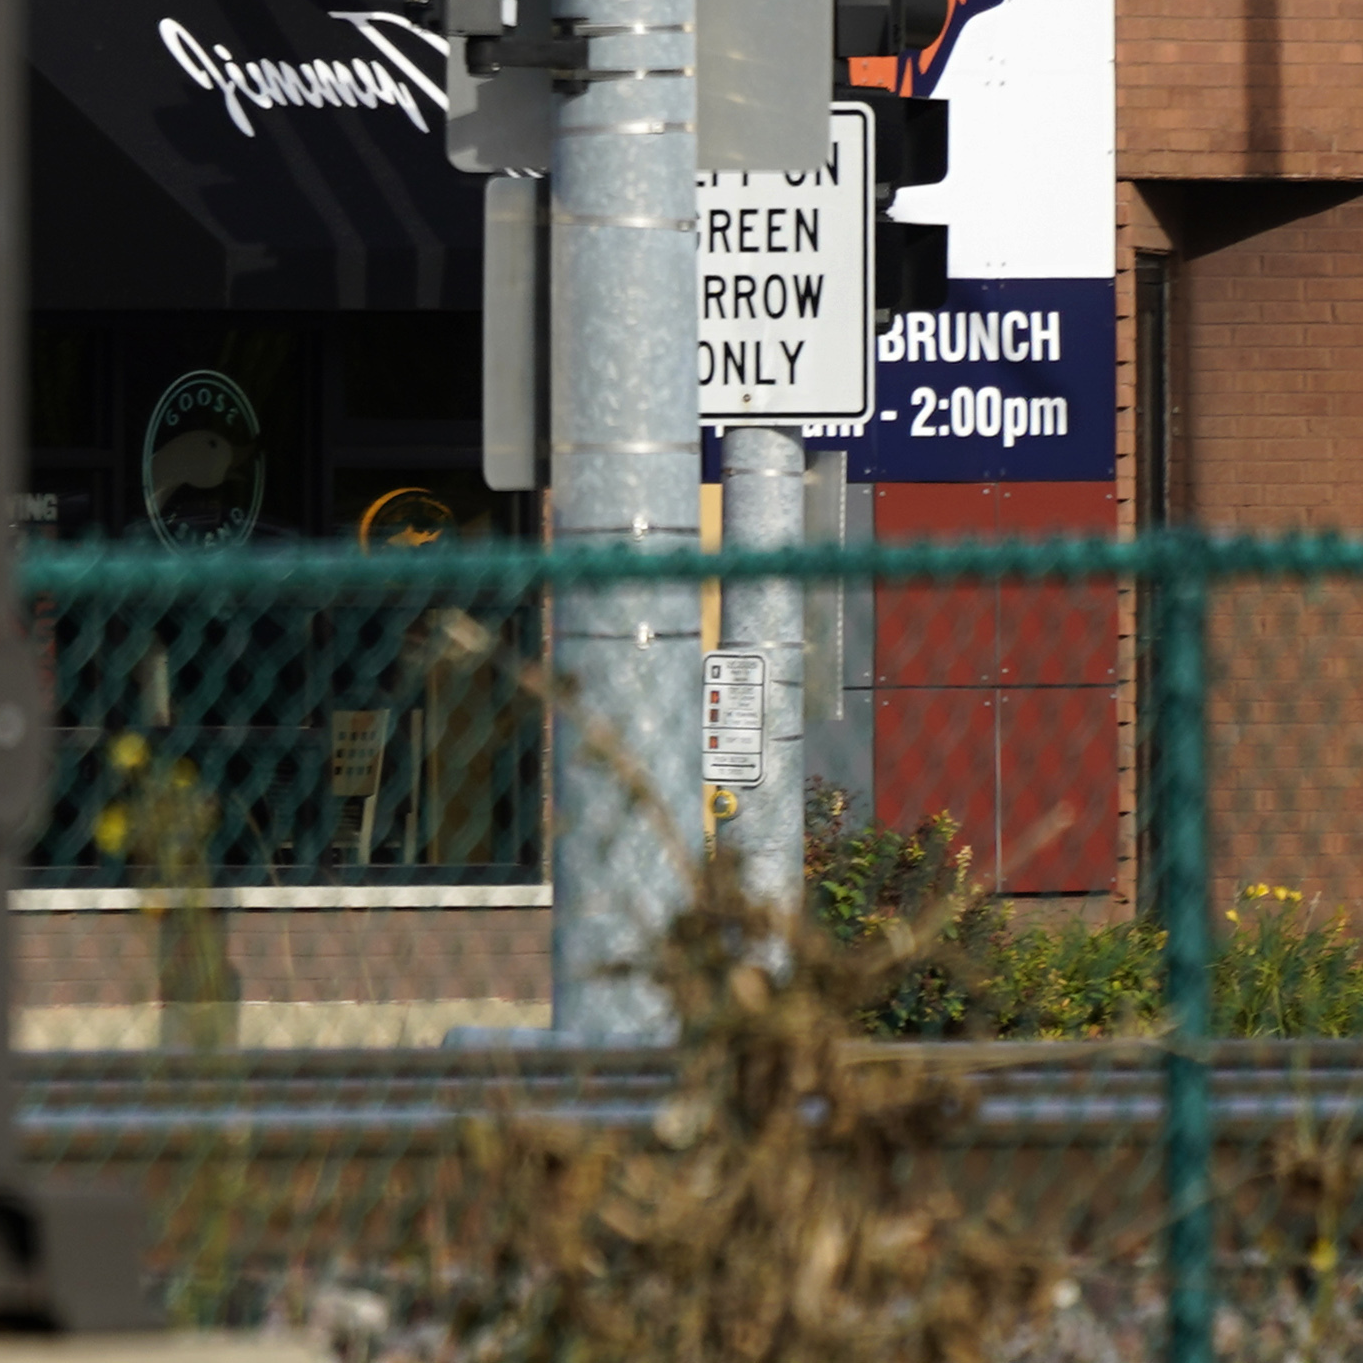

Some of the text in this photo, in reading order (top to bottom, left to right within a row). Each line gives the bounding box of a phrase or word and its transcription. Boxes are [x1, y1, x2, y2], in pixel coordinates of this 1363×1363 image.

[158, 17, 430, 138] Jimmy
[697, 207, 820, 254] REEN
[703, 273, 825, 320] RROW
[878, 310, 1061, 363] BRUNCH
[910, 386, 1069, 449] 2:00pm
